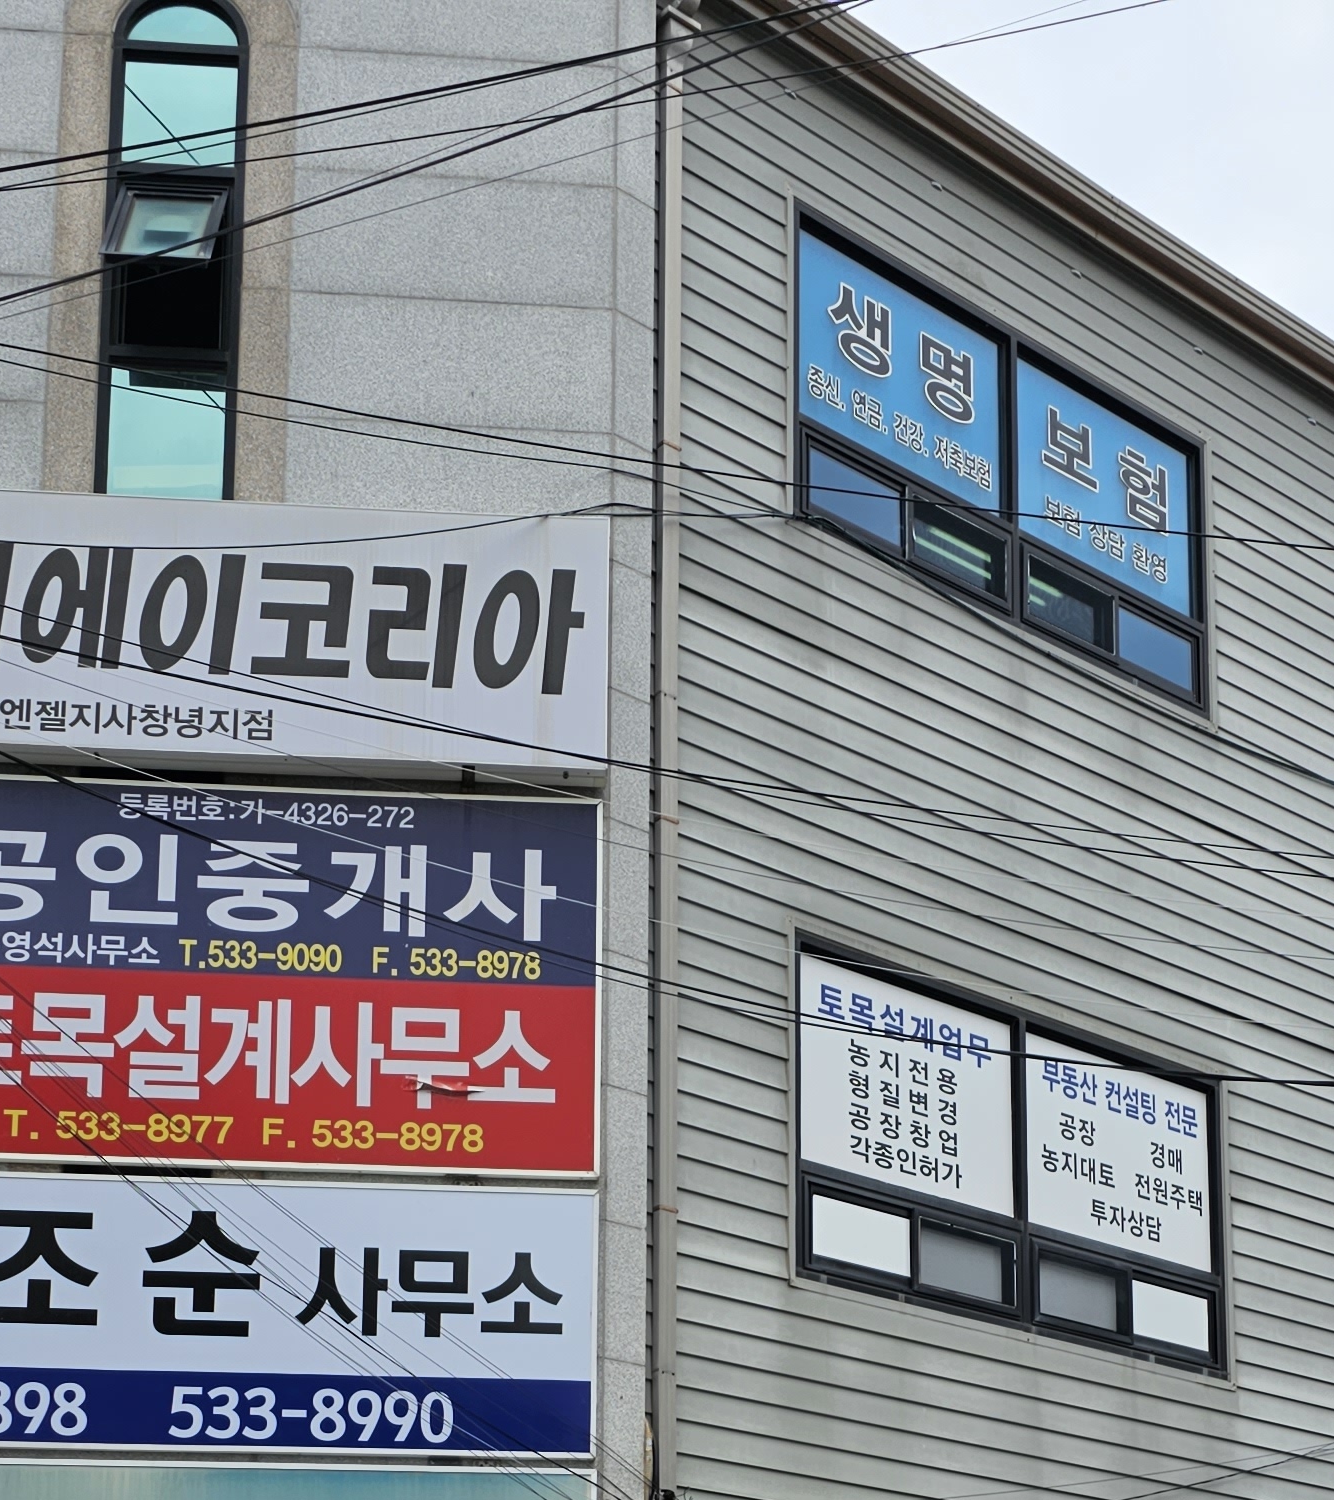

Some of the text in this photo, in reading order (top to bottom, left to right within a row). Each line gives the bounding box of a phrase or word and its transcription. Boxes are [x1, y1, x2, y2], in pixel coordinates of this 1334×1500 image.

[827, 281, 1168, 537] 생명 보험
[933, 434, 993, 492] 저축보험
[1042, 495, 1169, 584] 보험 상담 환영
[371, 947, 400, 977] F.
[408, 946, 543, 982] 533-8978
[817, 983, 992, 1069] 토목설계업무
[848, 1038, 958, 1096] 농지전용
[848, 1068, 958, 1127] 형질변경
[1041, 1057, 1199, 1139] 부동산 컨설팅 전문
[3, 1107, 485, 1153] T. 533-8977 F. 533-8978
[848, 1101, 959, 1158] 공장창업
[1058, 1112, 1184, 1175] 공장 경매
[848, 1134, 964, 1190] 각종인허가
[1040, 1143, 1204, 1217] 농지대토 전원주택
[1089, 1198, 1162, 1243] 투자상담
[295, 1245, 564, 1338] 사무소
[167, 1386, 454, 1446] 533-8990
